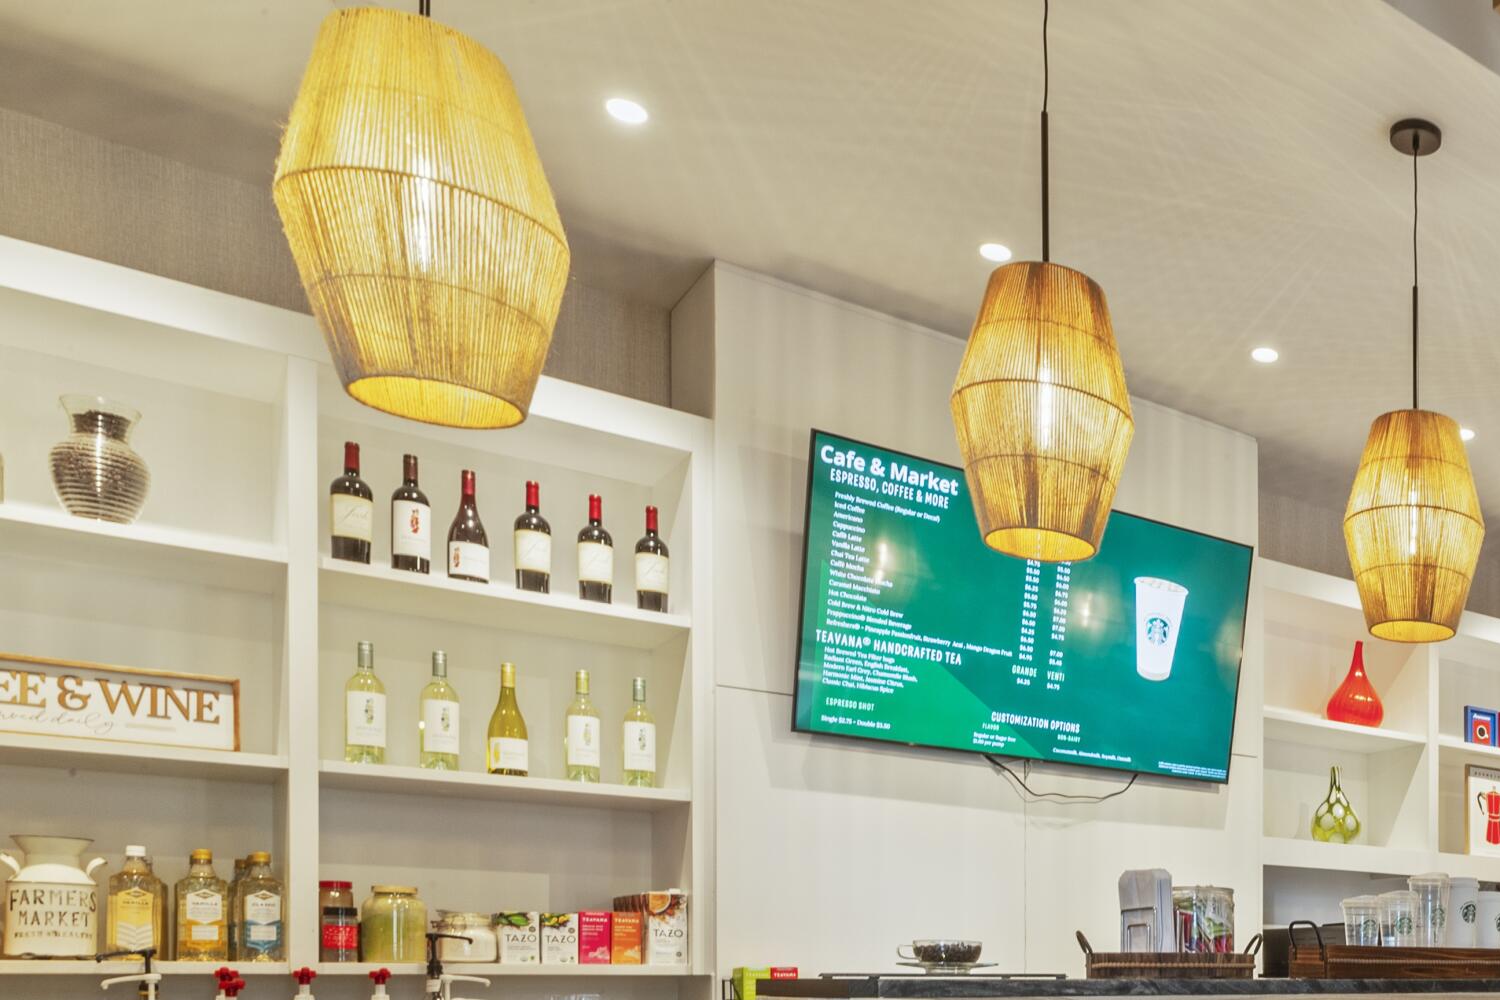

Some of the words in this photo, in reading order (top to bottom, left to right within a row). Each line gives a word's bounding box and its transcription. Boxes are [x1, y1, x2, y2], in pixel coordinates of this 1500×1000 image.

[821, 445, 865, 472] Cafe
[870, 458, 885, 477] &
[890, 462, 958, 495] Market
[830, 468, 879, 493] ESPRESSO,
[882, 481, 914, 500] COFFEE
[916, 490, 922, 502] &
[925, 492, 949, 509] MORE
[874, 639, 942, 662] HANDCRAFTED
[945, 651, 962, 665] TEA
[57, 674, 91, 711] &
[95, 677, 220, 724] WINE
[826, 697, 857, 709] ESPRESSO
[858, 702, 874, 711] SHOT
[992, 711, 1048, 729] CUSTOMIZATION
[1050, 720, 1080, 733] OPTIONS
[10, 889, 96, 912] FARMERS
[19, 910, 88, 927] MARKET
[504, 934, 536, 942] TAZO
[546, 935, 576, 943] TAZO
[654, 929, 683, 938] TAZO
